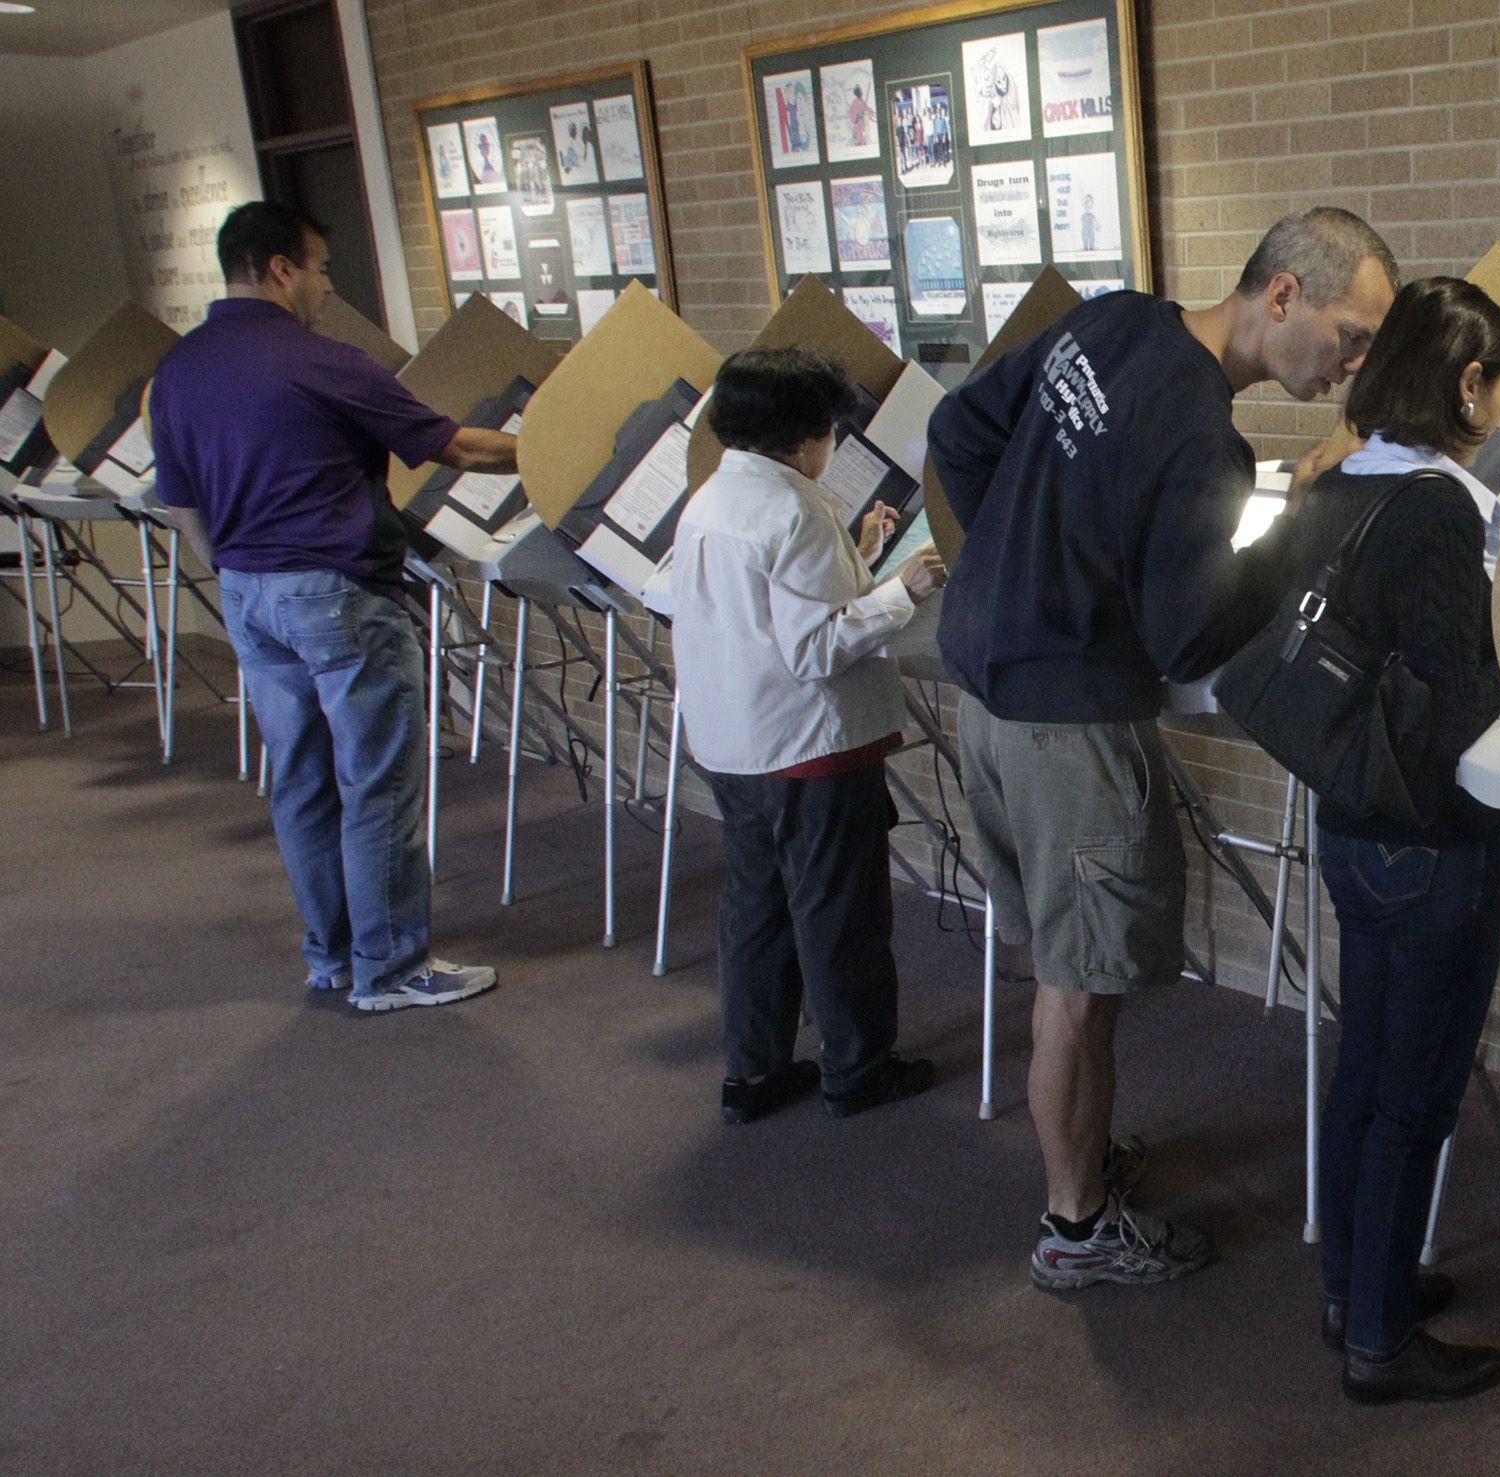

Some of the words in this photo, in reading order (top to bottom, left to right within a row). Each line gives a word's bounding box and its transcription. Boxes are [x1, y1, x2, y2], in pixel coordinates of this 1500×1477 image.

[977, 178, 1005, 187] Drugs
[1009, 176, 1029, 185] turn
[994, 209, 1012, 217] into
